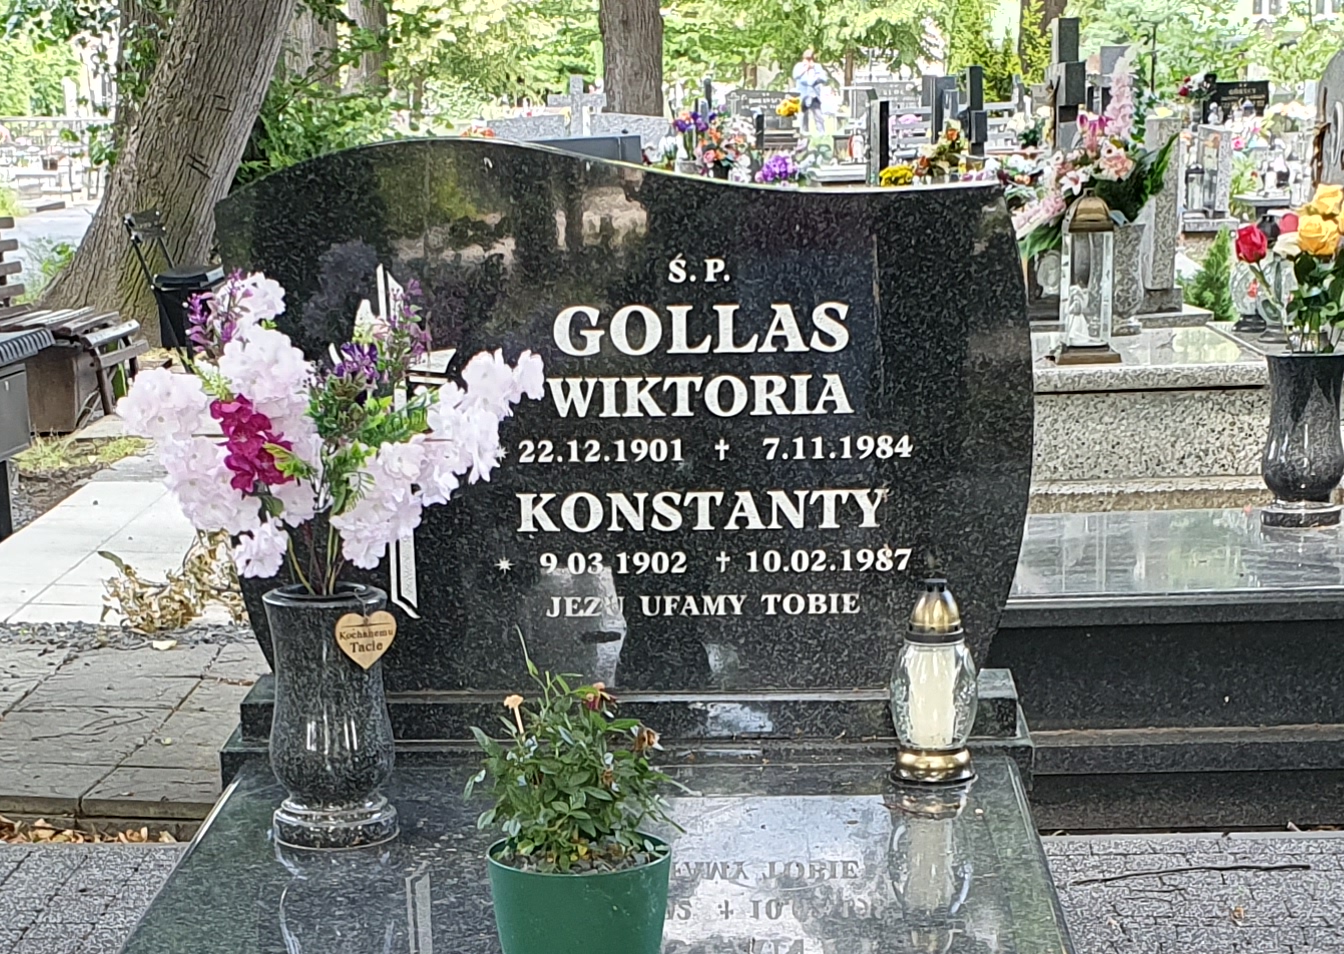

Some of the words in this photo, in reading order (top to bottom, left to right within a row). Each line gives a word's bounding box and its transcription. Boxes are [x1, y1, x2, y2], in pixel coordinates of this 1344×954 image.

[668, 253, 697, 283] Ś.
[704, 258, 731, 283] P.
[553, 302, 850, 357] GOLLAS
[546, 373, 854, 418] WIKTORIA
[518, 438, 684, 464] 22.12.1901
[762, 435, 913, 460] 7.11.1984
[516, 488, 889, 532] KONSTANTY
[746, 548, 912, 573] 10.02.1987
[546, 596, 625, 618] JEZU
[639, 594, 747, 617] UFAMY
[761, 593, 861, 616] TOBIE
